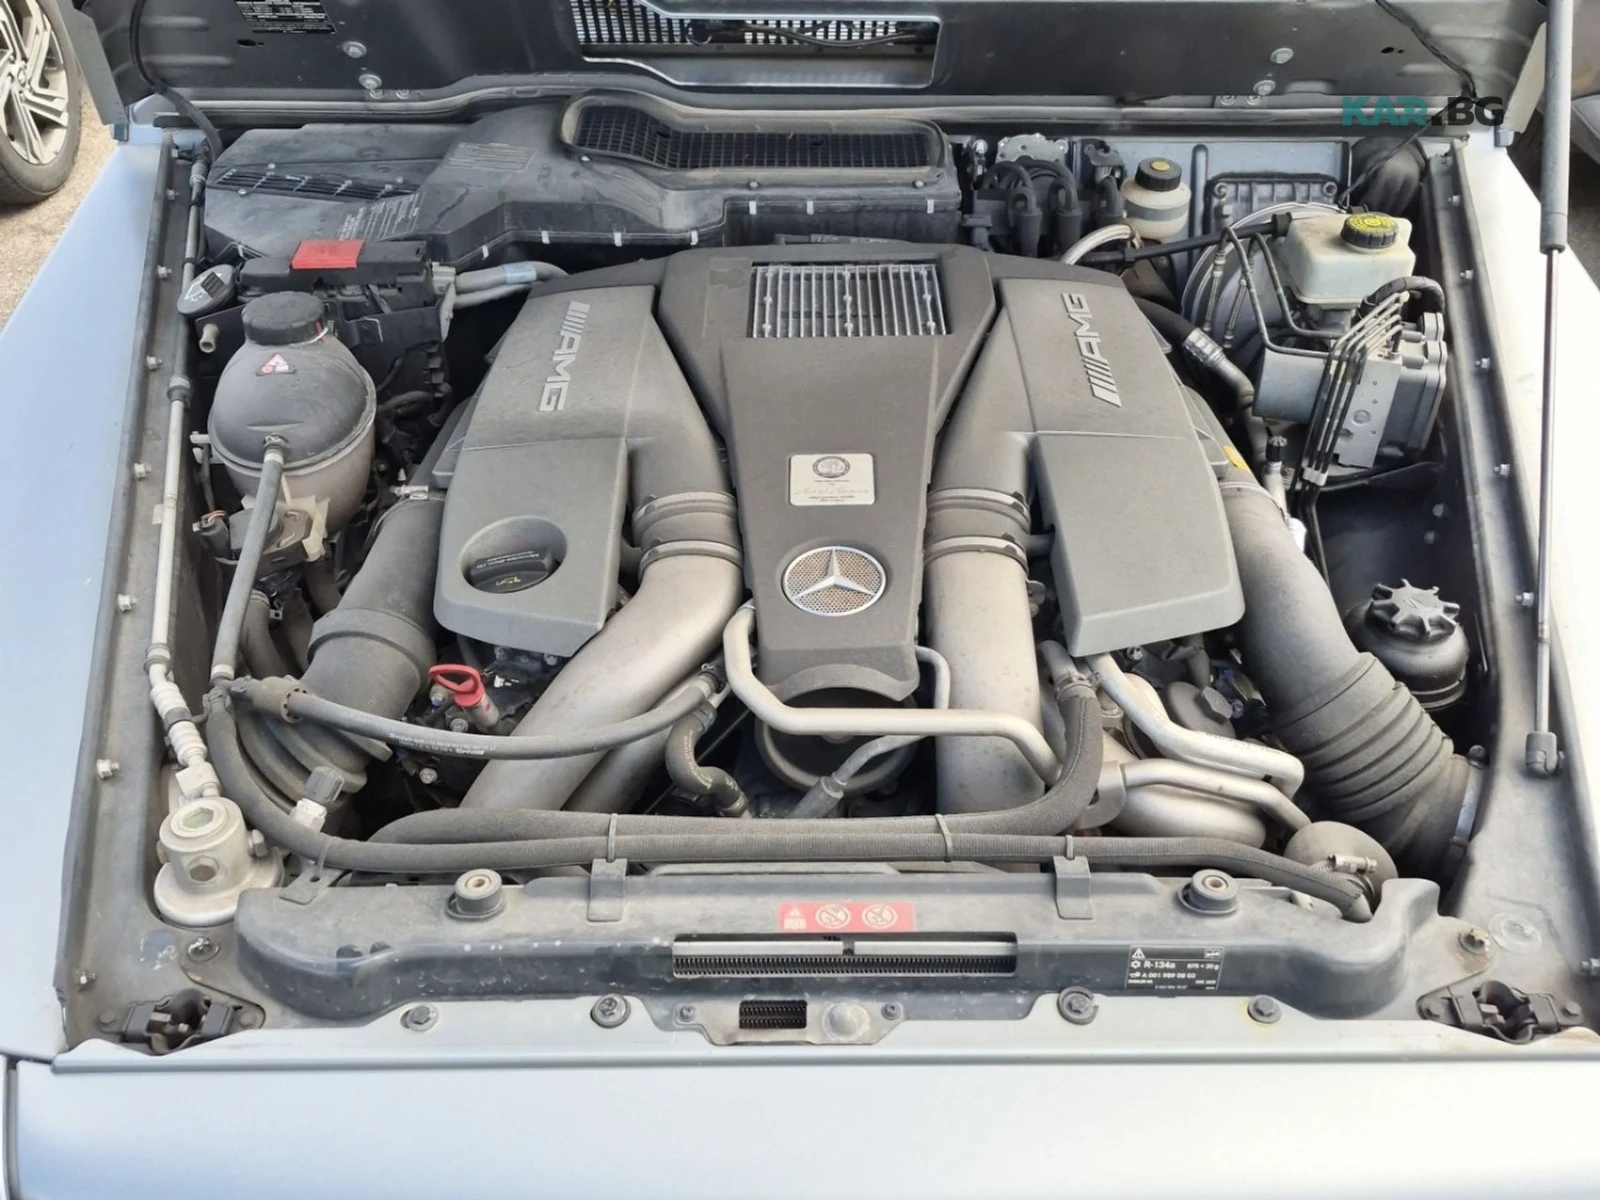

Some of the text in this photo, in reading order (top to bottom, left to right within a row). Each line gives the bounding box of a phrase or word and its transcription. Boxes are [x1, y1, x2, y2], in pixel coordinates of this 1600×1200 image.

[1061, 293, 1109, 368] AMG
[539, 329, 582, 412] AMG
[1143, 961, 1176, 969] R-134a
